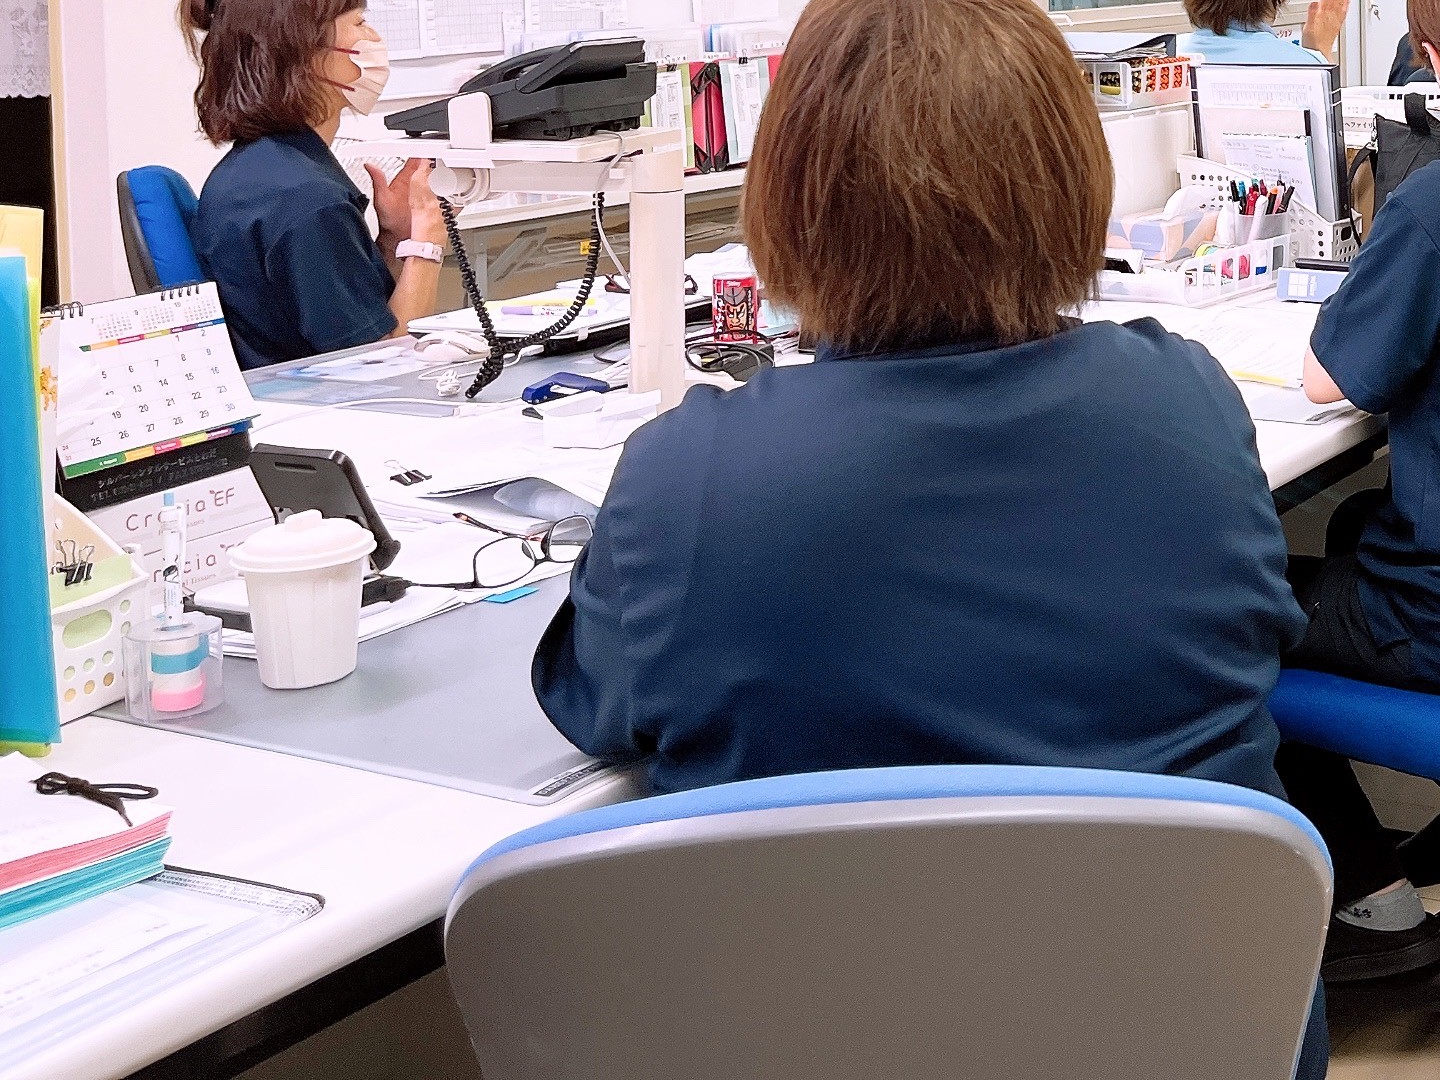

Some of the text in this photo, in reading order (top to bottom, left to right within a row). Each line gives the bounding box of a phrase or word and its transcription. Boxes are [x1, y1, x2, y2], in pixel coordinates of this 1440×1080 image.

[175, 329, 206, 342] 1 2
[101, 348, 212, 379] 5 6 7 8 9
[133, 366, 220, 394] 13 14 15 16
[111, 385, 227, 420] 19 20 21 22 23
[90, 403, 236, 447] 25 26 27 28 29 30
[126, 487, 235, 531] Cria EF
